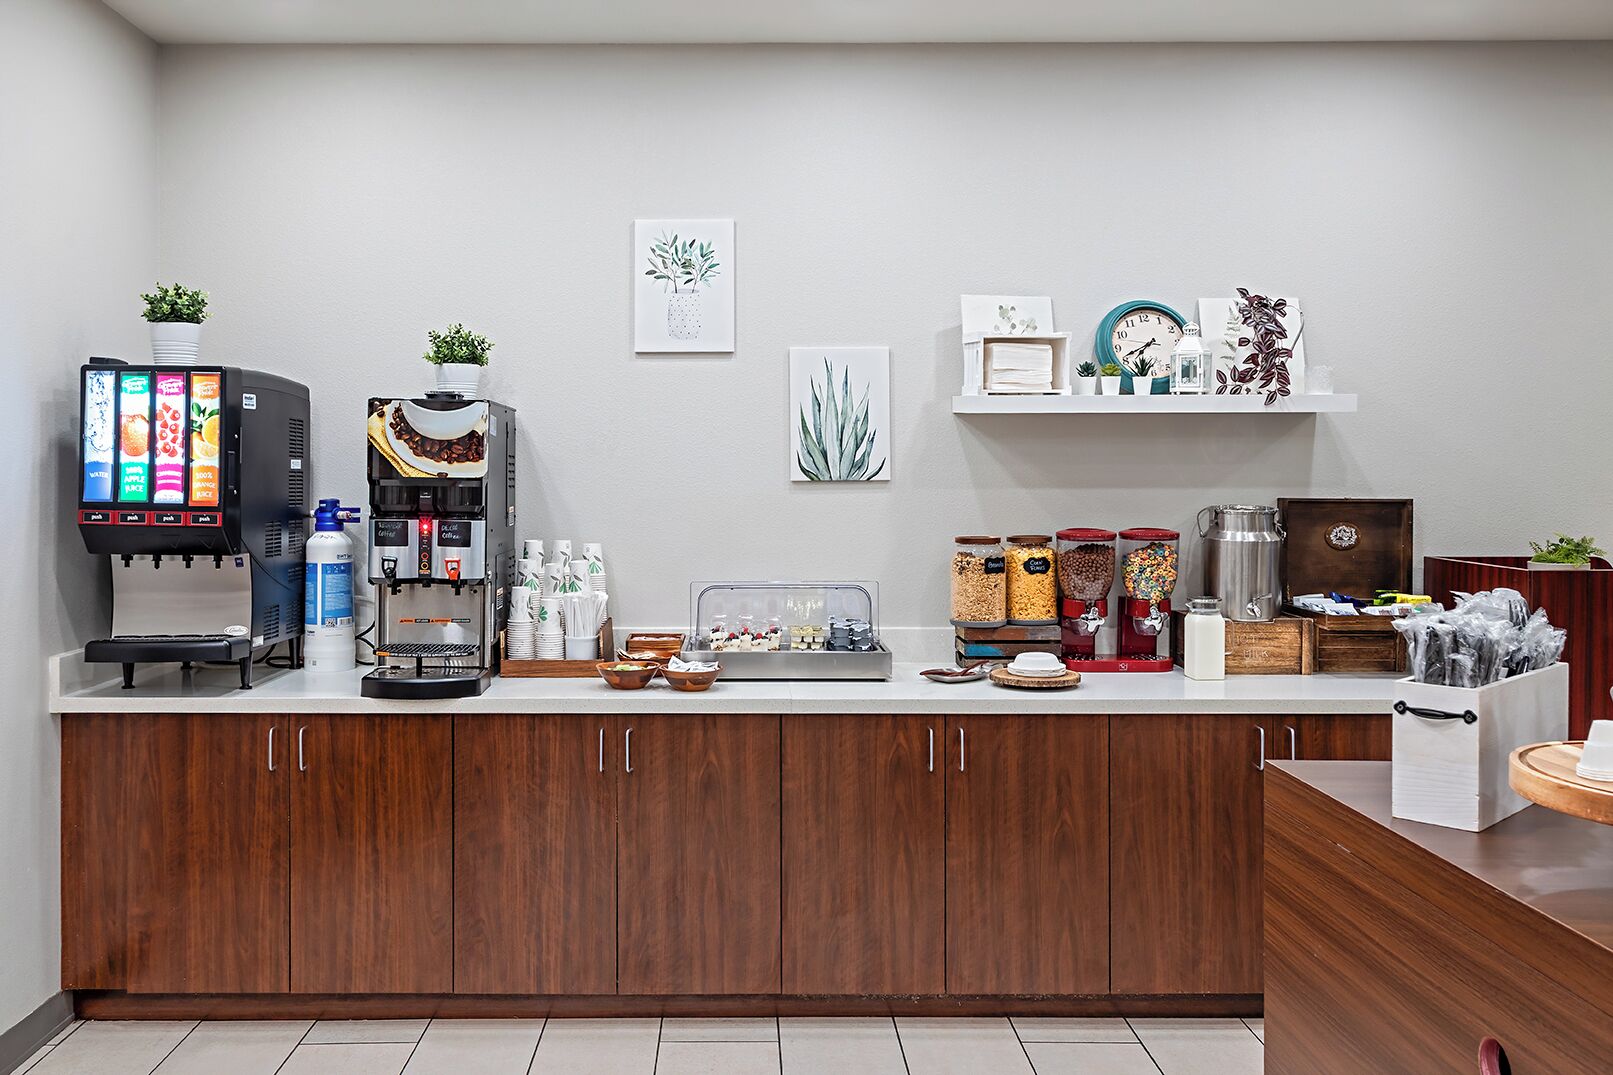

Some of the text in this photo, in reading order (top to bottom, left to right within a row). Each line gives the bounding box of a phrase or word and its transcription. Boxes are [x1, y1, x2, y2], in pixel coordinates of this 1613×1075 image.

[1139, 314, 1150, 322] 12
[1126, 320, 1134, 328] 11
[1117, 330, 1128, 338] 10
[1114, 344, 1122, 352] 9
[1122, 357, 1130, 365] 8
[124, 475, 145, 483] APPLE
[125, 484, 144, 494] JUICE
[196, 491, 213, 499] JUICE
[1244, 649, 1269, 659] MILK
